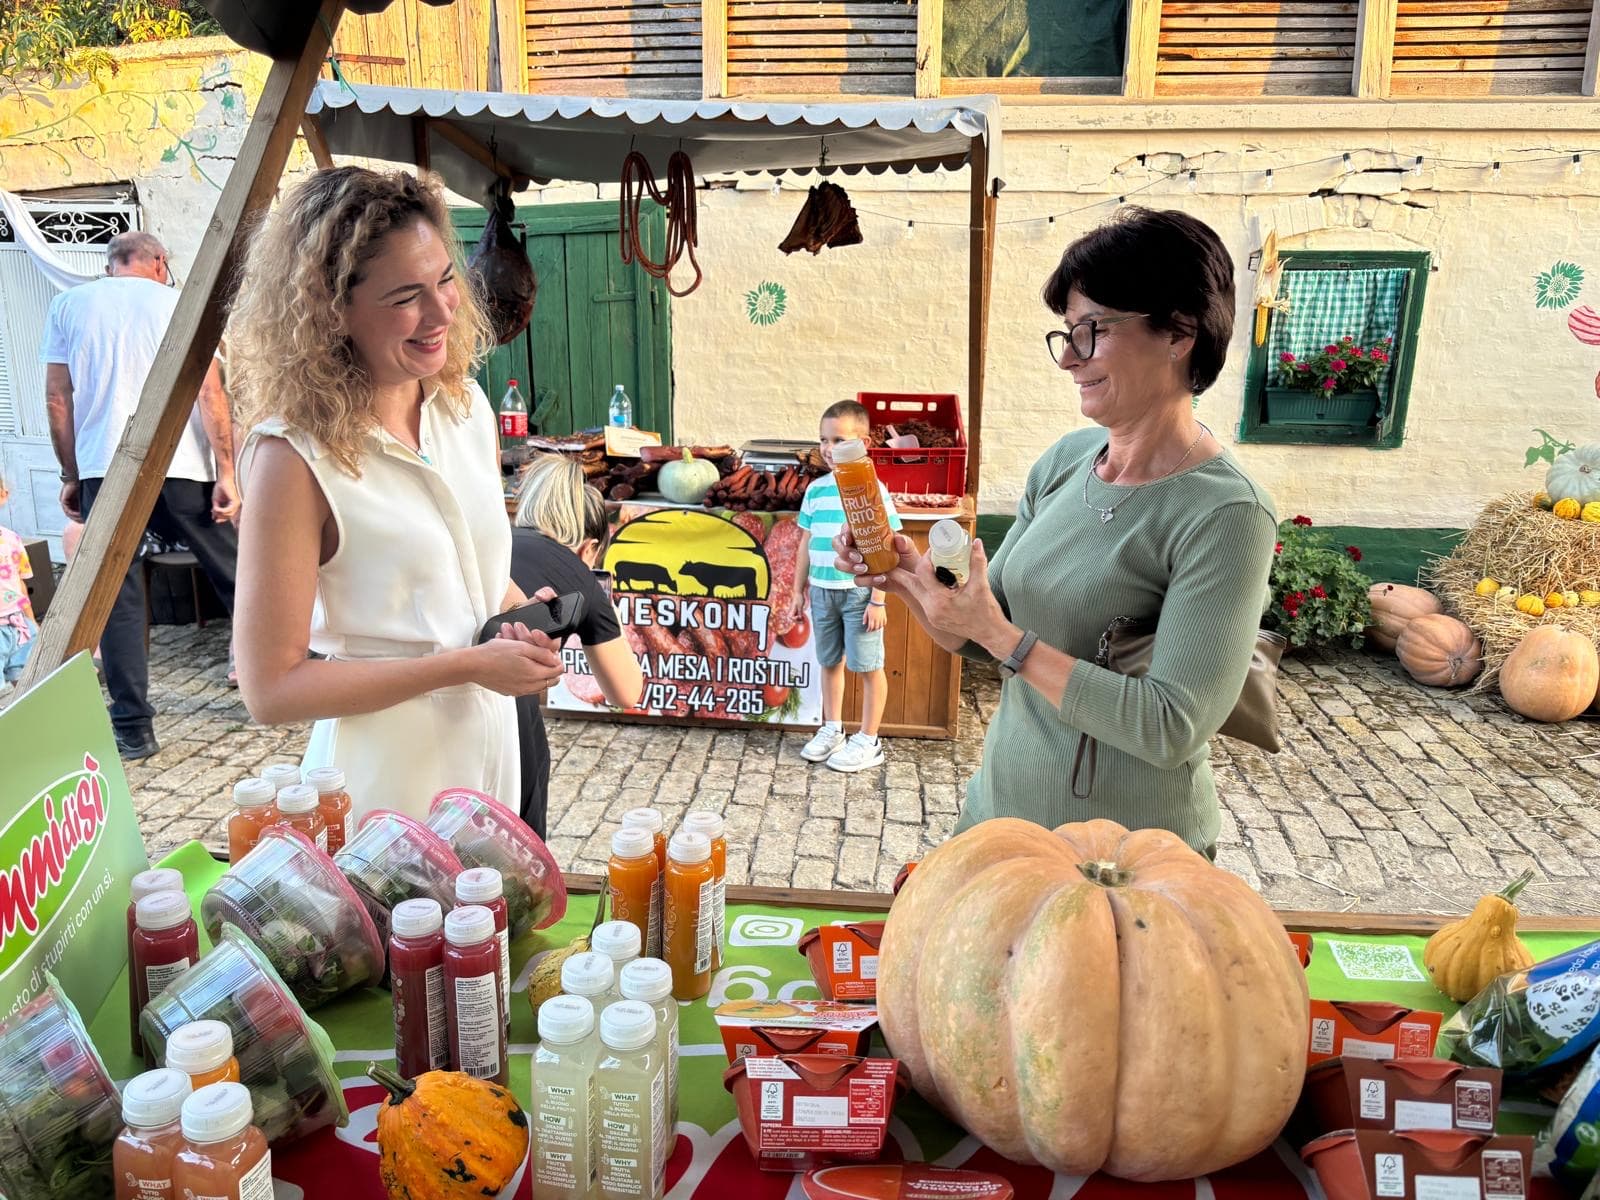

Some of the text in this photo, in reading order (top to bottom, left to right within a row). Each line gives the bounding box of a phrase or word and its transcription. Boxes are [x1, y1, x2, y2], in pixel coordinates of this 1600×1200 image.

[843, 495, 872, 510] FRUL
[658, 655, 709, 681] MESA
[717, 659, 722, 681] I
[729, 656, 809, 687] ROŠTILJ
[634, 684, 763, 714] /92-44-285
[30, 962, 42, 993] di
[41, 917, 76, 974] stupirti
[75, 903, 94, 928] con
[93, 885, 105, 906] un
[103, 869, 114, 892] sì.
[551, 1087, 572, 1095] WHAT
